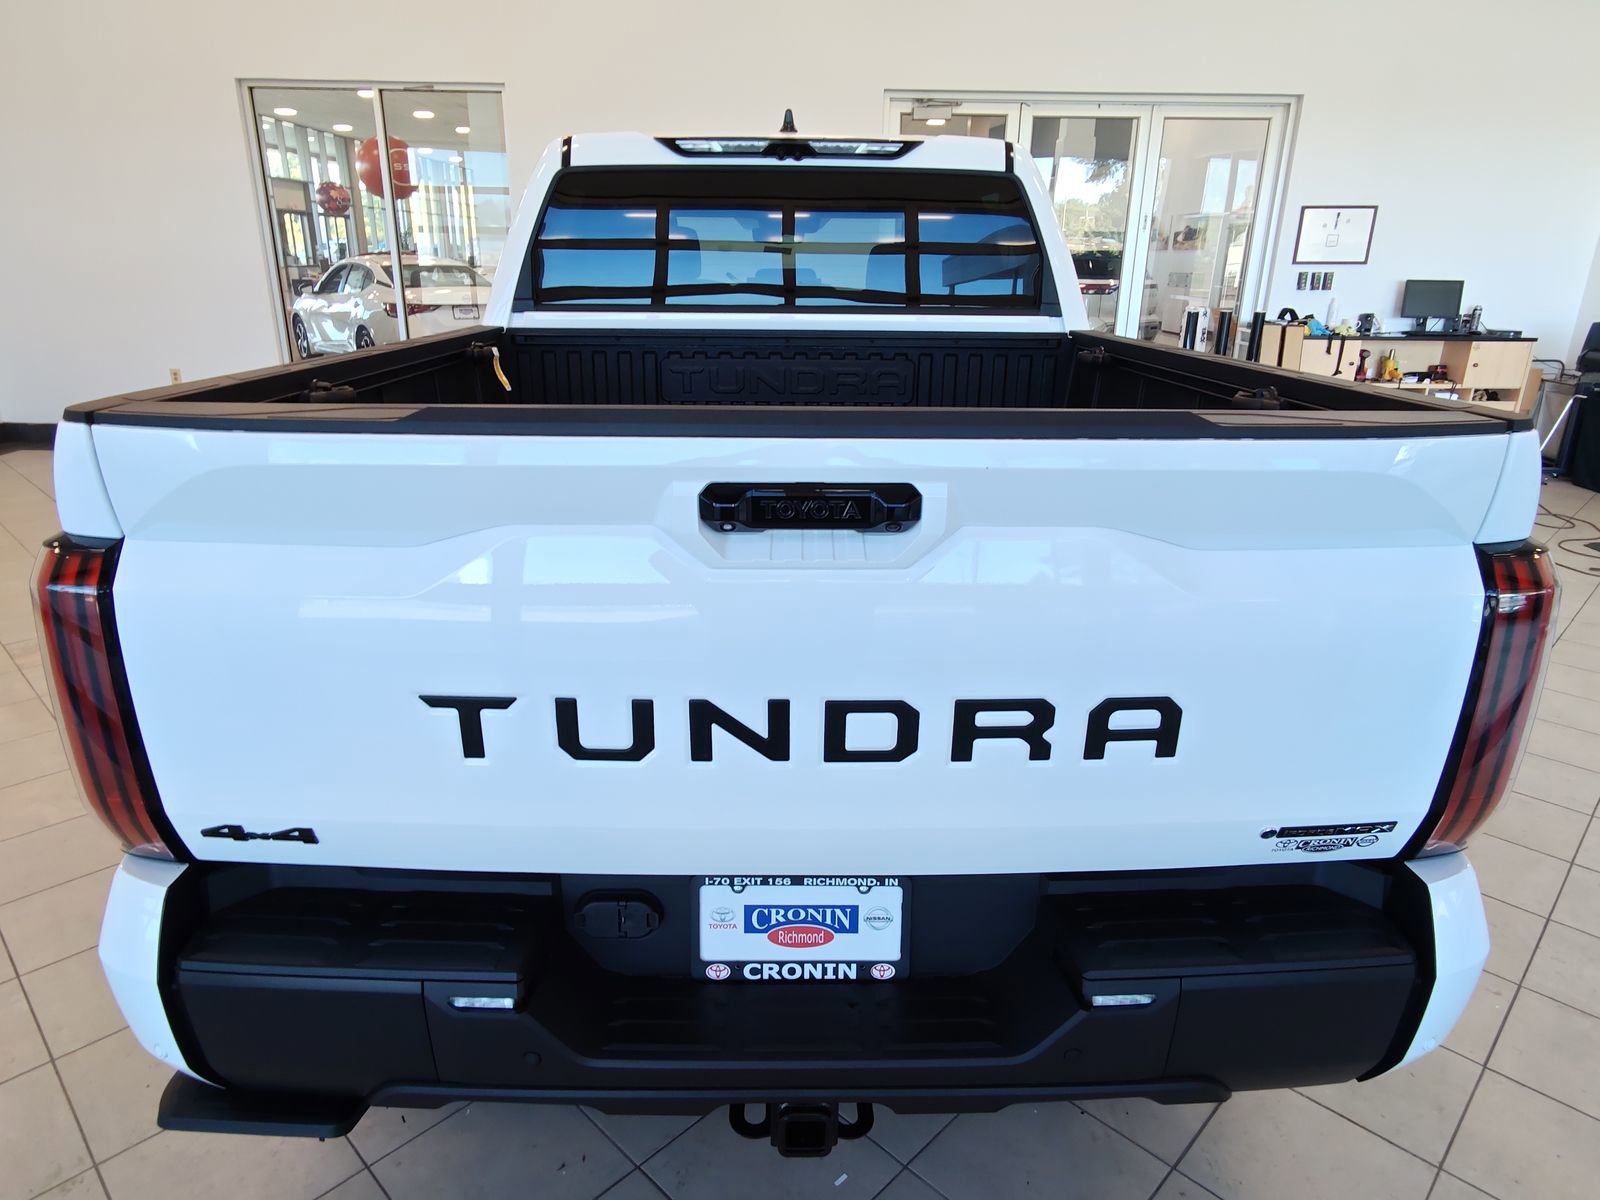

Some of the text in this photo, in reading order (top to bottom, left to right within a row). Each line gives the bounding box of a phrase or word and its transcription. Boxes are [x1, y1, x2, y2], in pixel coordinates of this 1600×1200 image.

[669, 365, 907, 396] TUNDRA
[760, 499, 862, 520] TOYOTA
[418, 694, 1184, 763] TUNDRA
[1299, 838, 1356, 848] CRONIN
[705, 877, 730, 886] I-70
[734, 877, 764, 886] EXIT
[767, 877, 792, 886] 156
[884, 877, 899, 886] IN
[751, 907, 852, 930] CRONIN
[778, 930, 825, 944] Richmond
[743, 963, 857, 980] CRONIN
